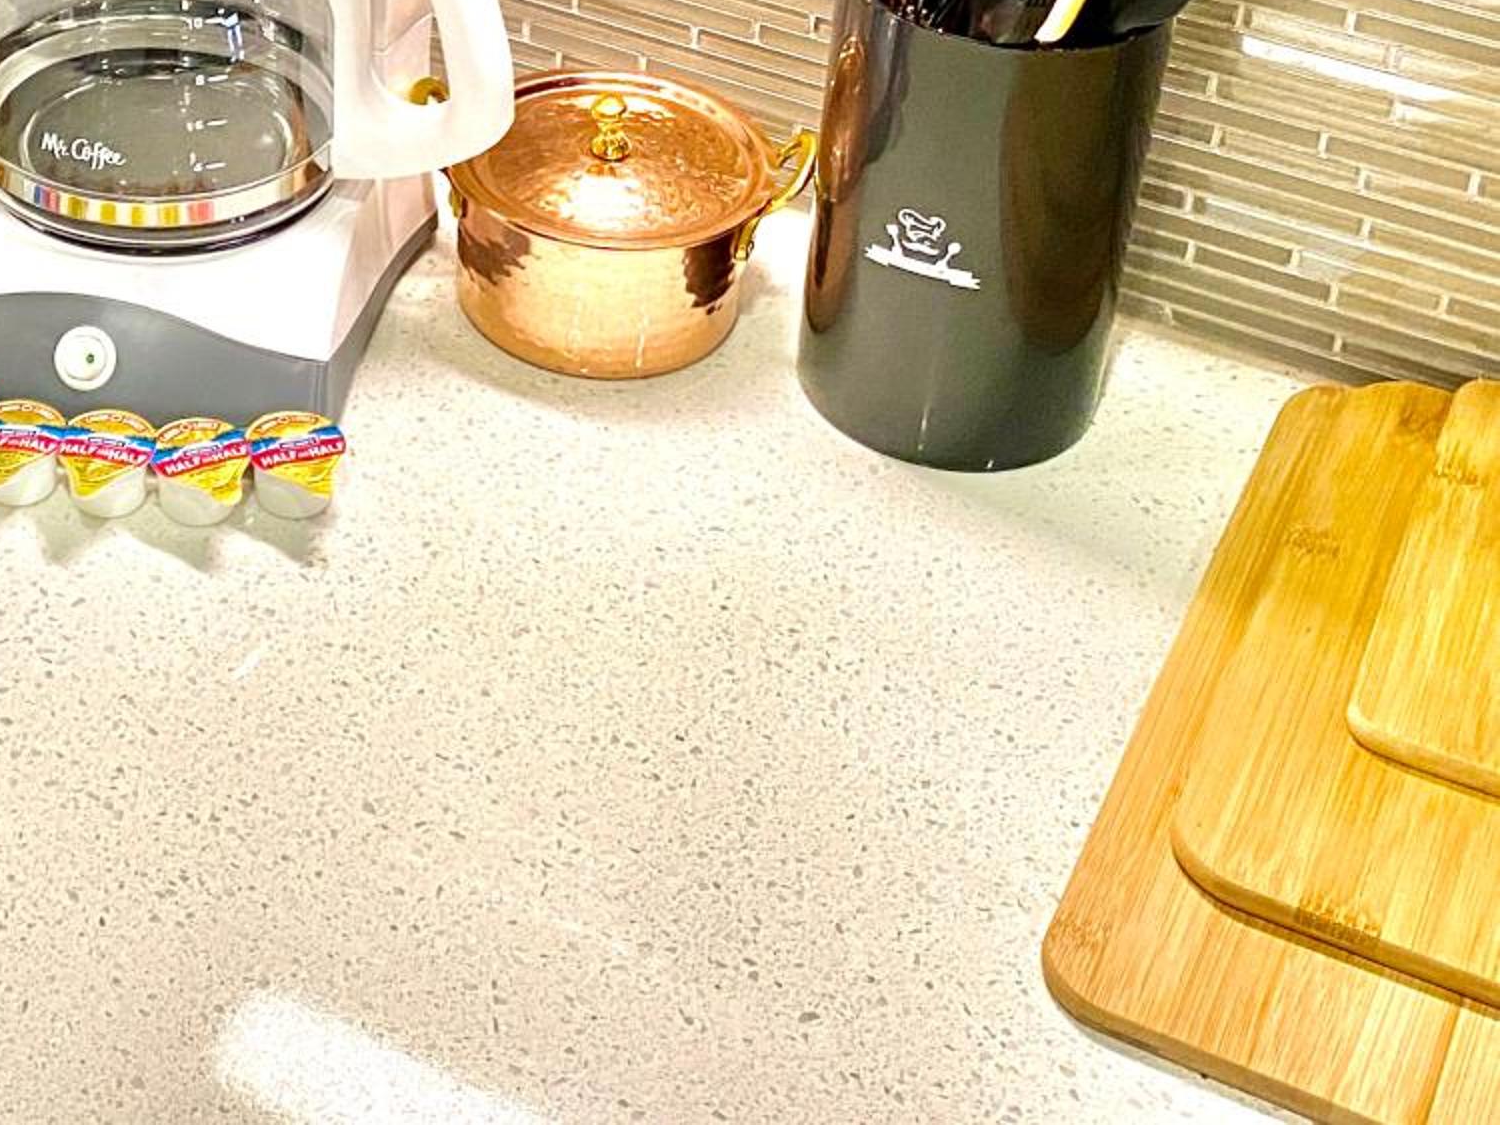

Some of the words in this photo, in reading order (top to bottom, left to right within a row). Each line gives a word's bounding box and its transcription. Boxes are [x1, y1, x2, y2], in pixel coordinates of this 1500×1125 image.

[71, 138, 127, 170] Coffee
[18, 438, 58, 452] HALF
[60, 442, 96, 455] HALF
[108, 450, 148, 463] HALF
[260, 451, 298, 468] HALF
[309, 442, 344, 458] HALF
[164, 458, 202, 476] HALF
[212, 444, 249, 461] HALF
